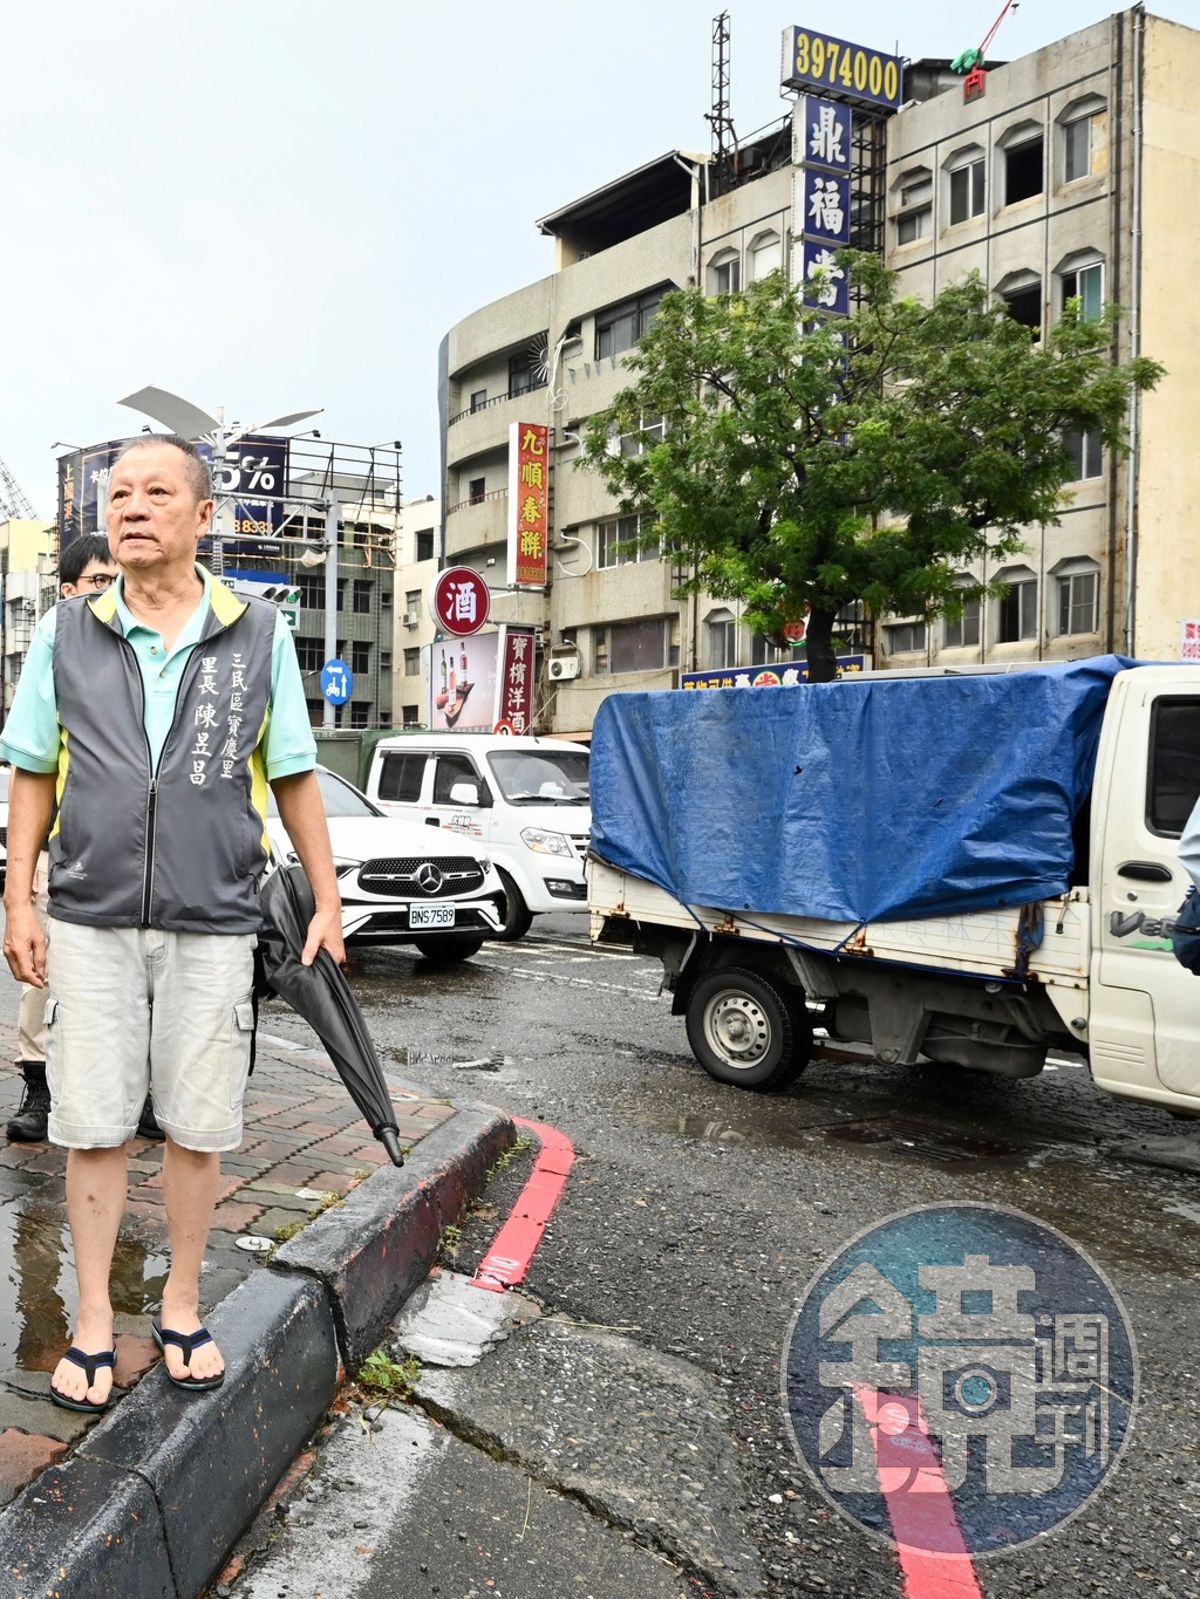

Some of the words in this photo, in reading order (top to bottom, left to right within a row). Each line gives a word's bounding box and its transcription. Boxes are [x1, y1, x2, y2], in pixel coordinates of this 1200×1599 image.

[796, 33, 898, 101] 3974000
[806, 105, 847, 352] 鼎福當
[446, 581, 477, 624] 酒
[198, 656, 220, 696] 里長
[189, 702, 220, 786] 陳昱昌
[411, 909, 454, 924] BNS-7589
